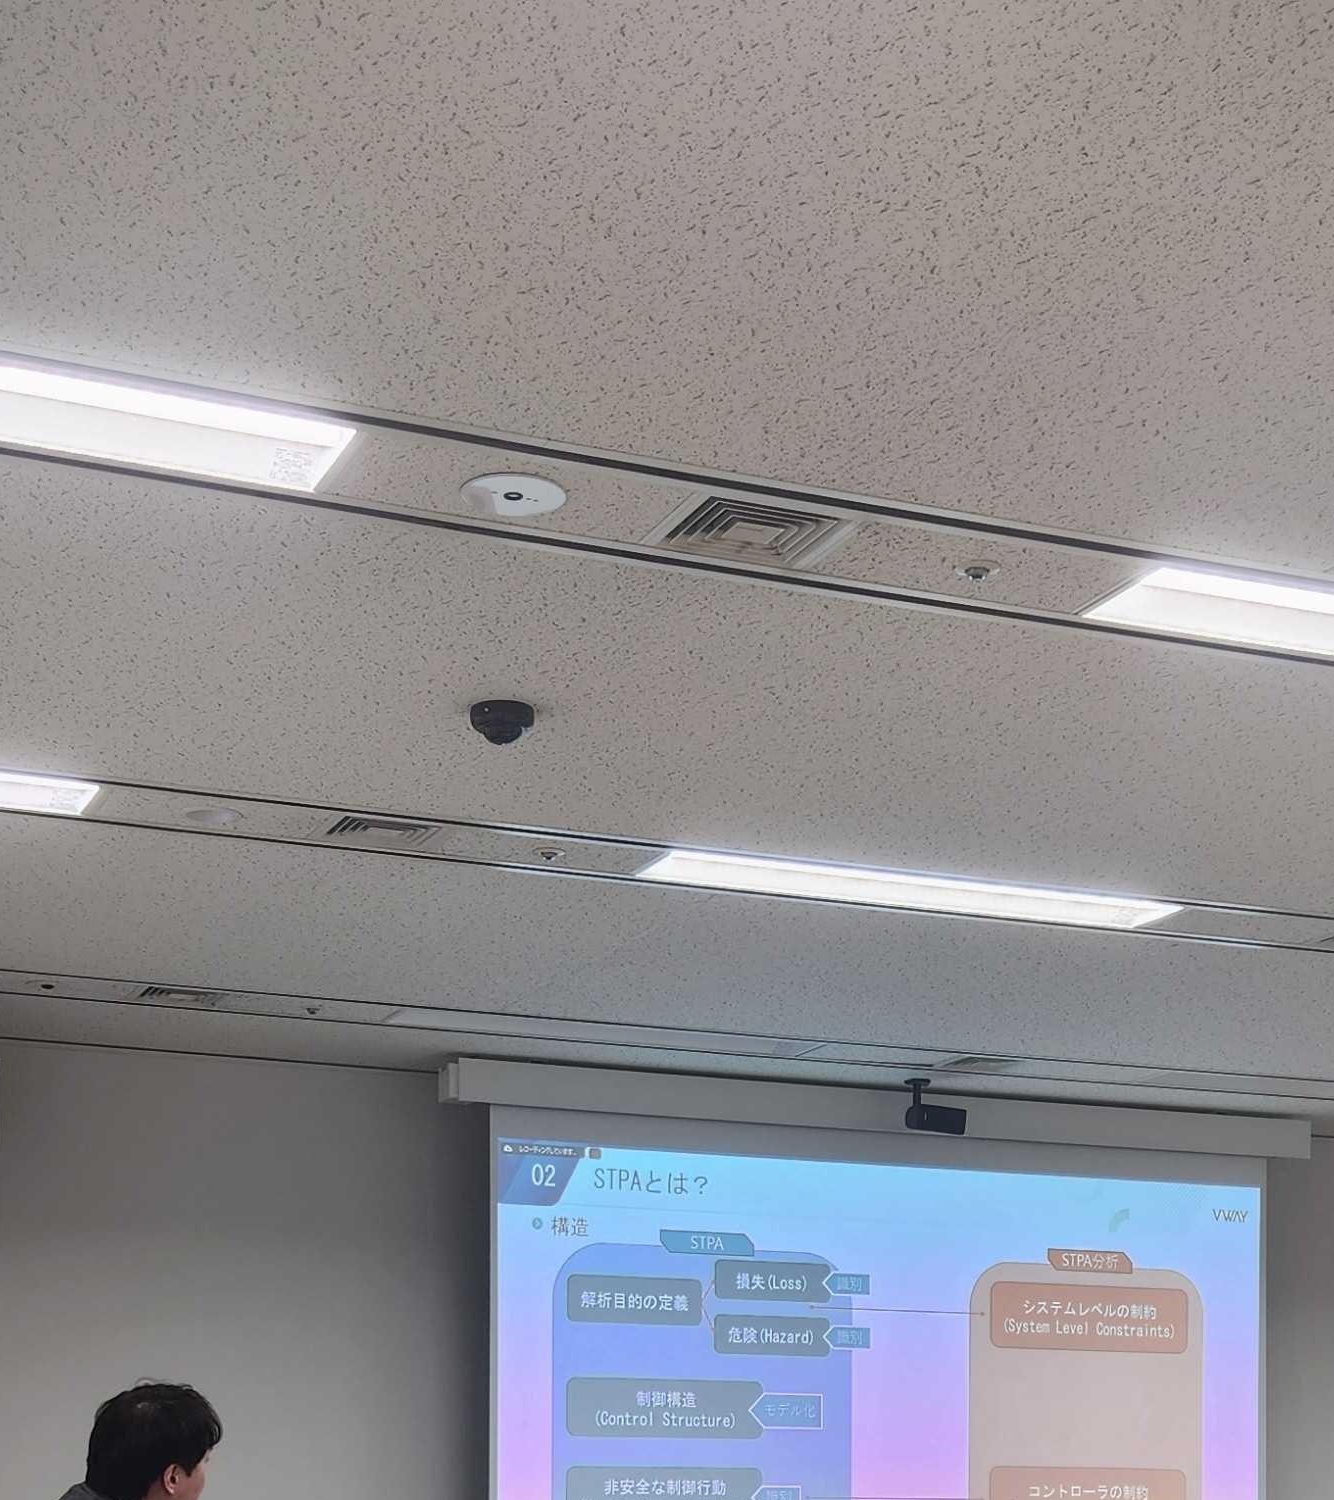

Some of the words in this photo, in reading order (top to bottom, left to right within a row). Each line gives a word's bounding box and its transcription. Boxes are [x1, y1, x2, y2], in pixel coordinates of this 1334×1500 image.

[531, 1163, 556, 1187] 02
[1212, 1208, 1249, 1223] VWAY
[551, 1216, 589, 1238] 構造
[690, 1236, 724, 1250] STPA
[1061, 1252, 1119, 1270] STPA分析
[580, 1291, 689, 1312] 解析目的の定義
[1022, 1300, 1157, 1319] システムレベルの制約
[1003, 1318, 1050, 1334] (System
[1055, 1319, 1088, 1335] Level
[1096, 1321, 1175, 1338] Constraints)
[636, 1391, 697, 1408] 制御構造
[764, 1403, 816, 1418] モデル化
[595, 1411, 653, 1427] (Control
[662, 1411, 736, 1428] Structure)
[603, 1479, 727, 1496] 非安全な制御行動
[1028, 1485, 1149, 1500] コントローラの制約
